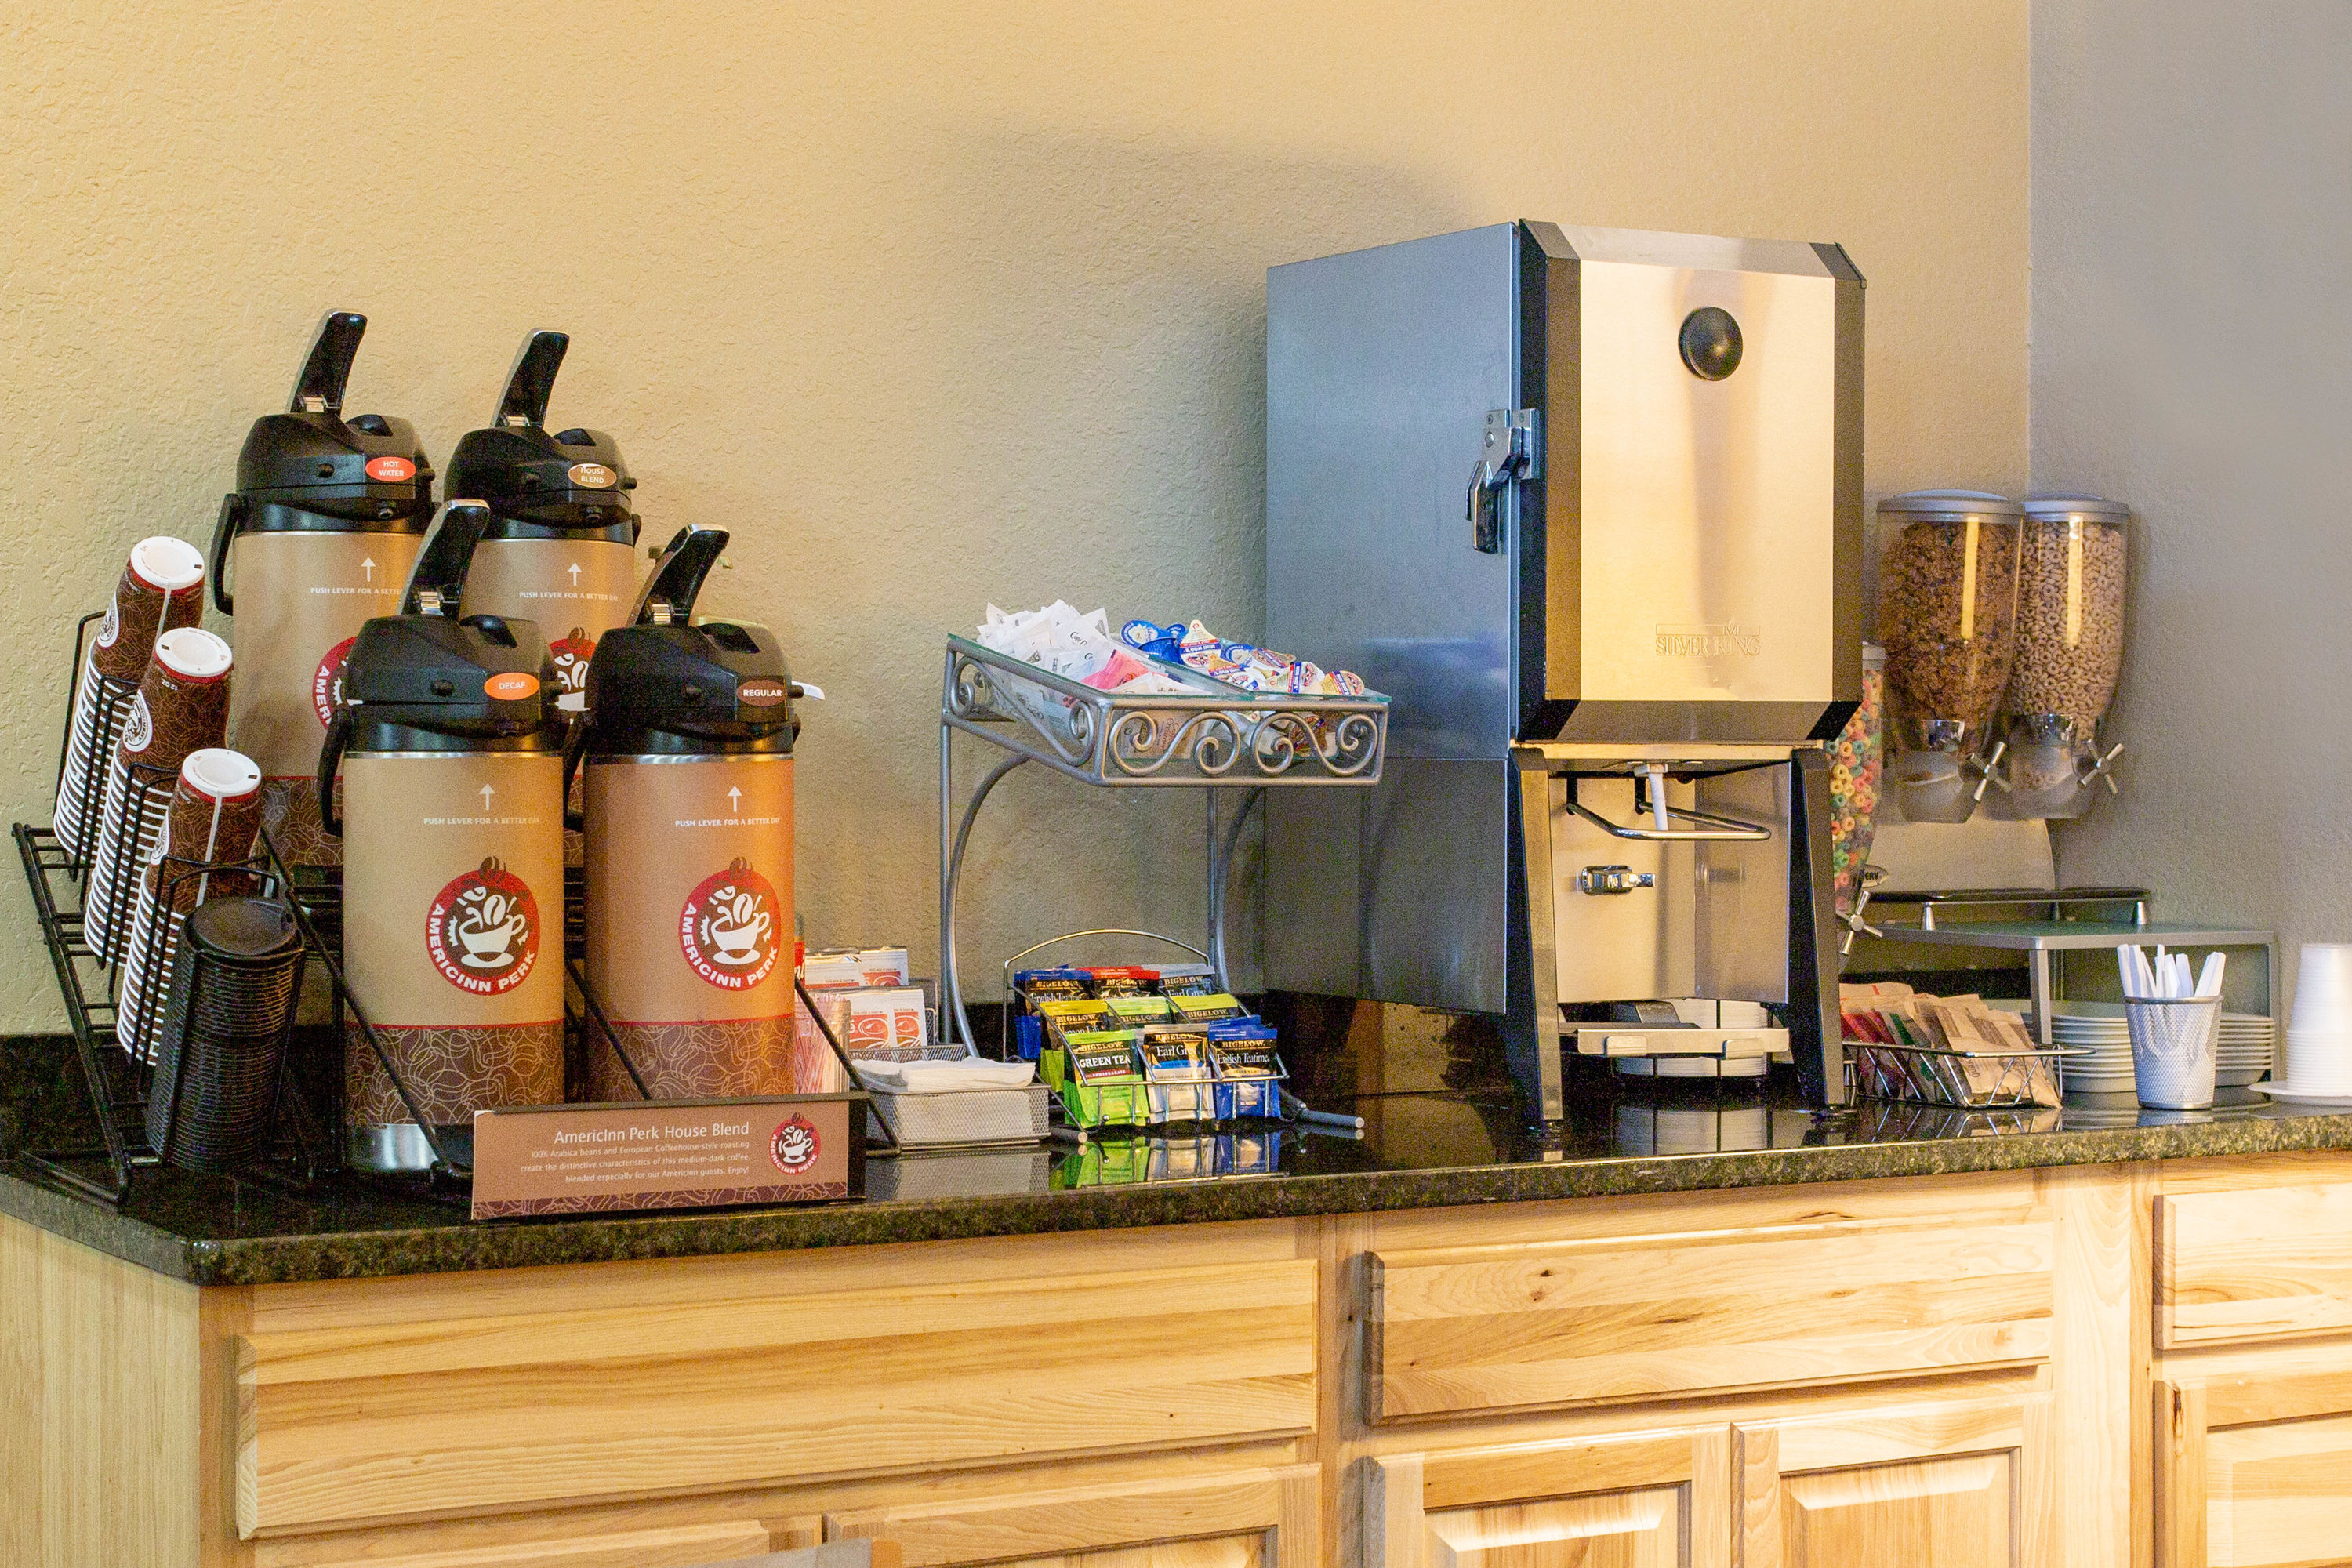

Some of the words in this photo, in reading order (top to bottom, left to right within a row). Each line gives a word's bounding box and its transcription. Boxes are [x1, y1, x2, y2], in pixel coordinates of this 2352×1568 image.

[581, 467, 605, 476] HOUSE
[1655, 636, 1711, 656] SILVER
[1713, 636, 1761, 656] KING
[161, 678, 170, 688] OZ
[499, 681, 525, 690] DECAF
[429, 903, 491, 993] AMERICINN
[498, 949, 535, 990] PERK
[682, 902, 741, 988] AMERICINN
[747, 946, 778, 985] PERK
[1164, 975, 1203, 985] BIGELOW
[1056, 1014, 1098, 1023] BIGELOW
[1187, 1009, 1228, 1018] BIGELOW
[1155, 1034, 1197, 1043] BIGELOW
[1222, 1040, 1265, 1048] BIGELOW
[1080, 1040, 1124, 1051] BIGELOW
[1156, 1045, 1175, 1057] Earl
[1080, 1056, 1112, 1068] GREEN
[1112, 1055, 1131, 1065] TEA
[1218, 1053, 1241, 1064] English
[554, 1129, 626, 1144] AmericInn
[630, 1126, 659, 1140] Perk
[665, 1125, 707, 1138] House
[712, 1121, 750, 1136] Blend
[619, 1145, 653, 1155] European
[720, 1141, 750, 1149] roasting
[771, 1134, 796, 1174] AMERICINN
[798, 1154, 818, 1173] PERK
[559, 1161, 597, 1171] distinctive
[599, 1158, 651, 1168] characteristics
[678, 1154, 724, 1163] medium-dark
[566, 1174, 595, 1183] blended
[597, 1171, 633, 1181] especially
[700, 1167, 725, 1177] guests.
